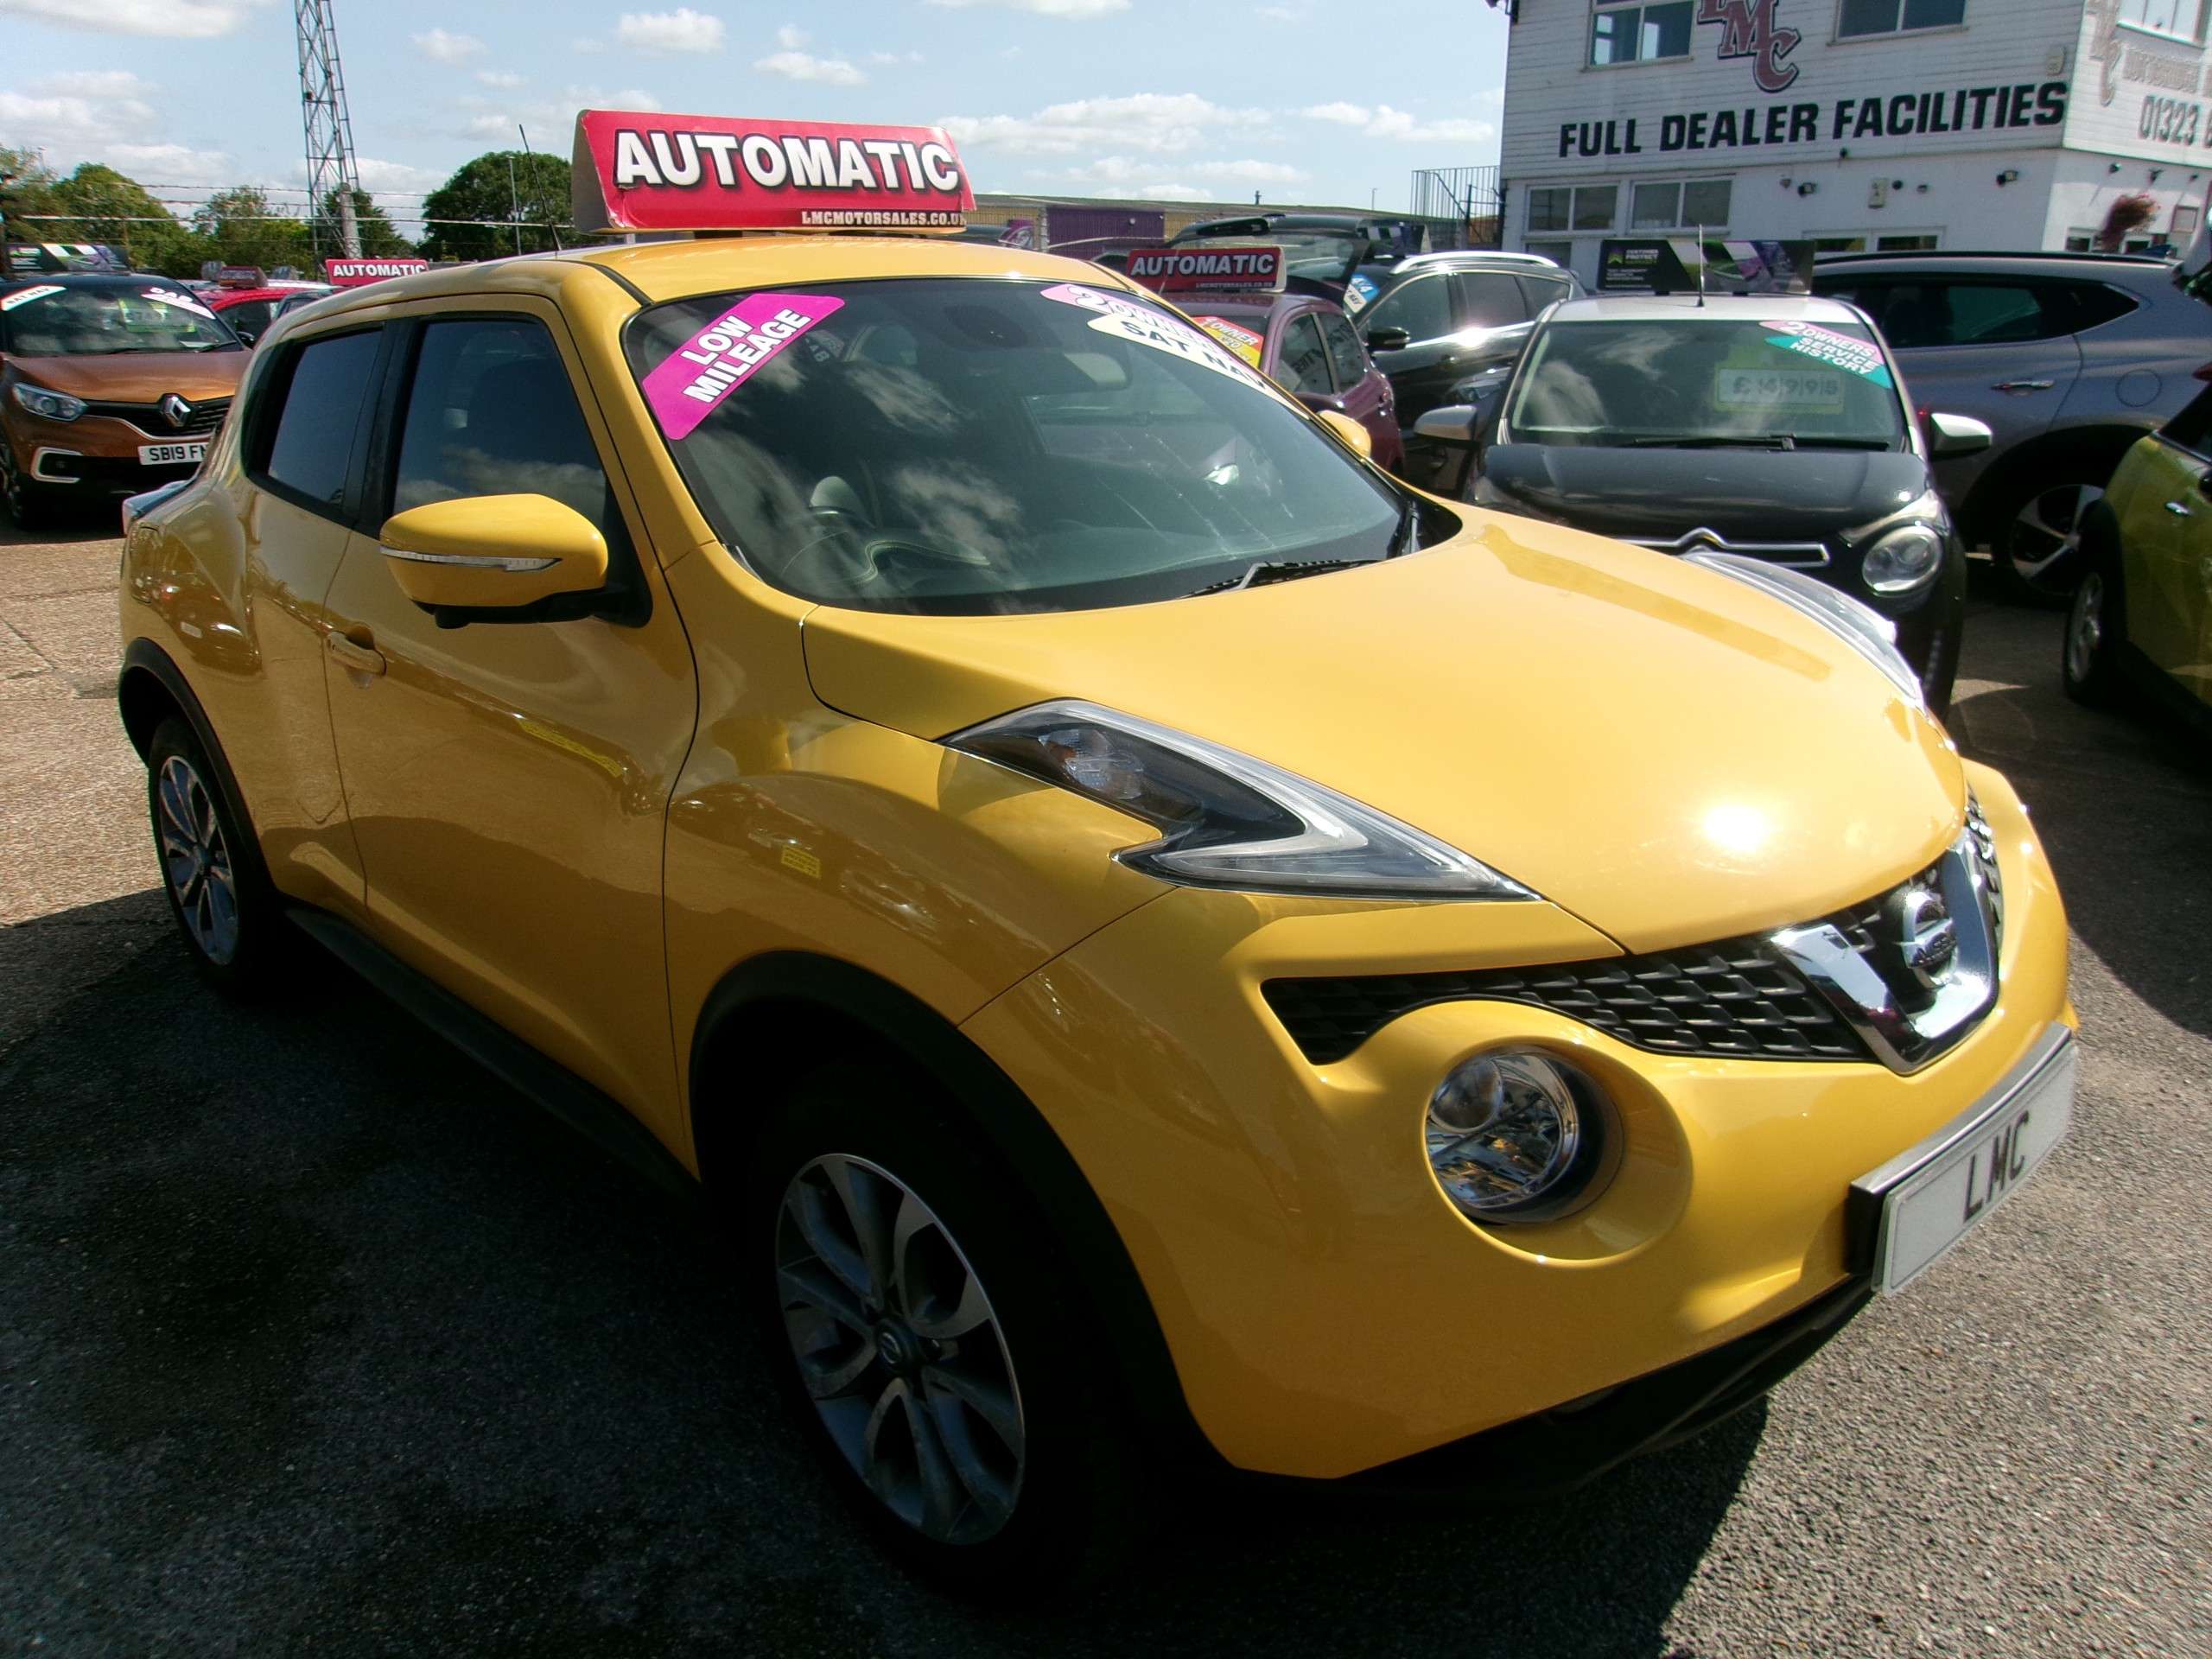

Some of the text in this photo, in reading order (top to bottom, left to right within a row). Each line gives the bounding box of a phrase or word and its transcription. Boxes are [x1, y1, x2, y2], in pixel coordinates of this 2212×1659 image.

[1559, 81, 2069, 158] FULL DEALER FACILITIES
[2139, 95, 2201, 146] 01323
[616, 131, 960, 192] AUTOMATIC
[332, 264, 426, 276] AUTOMATIC
[1129, 253, 1274, 276] AUTOMATIC
[680, 315, 755, 365] LOW
[1121, 321, 1189, 351] SAT
[1204, 351, 1267, 389] NAV
[1210, 321, 1259, 346] OWNER
[1780, 321, 1876, 357] 2 OWNERS
[1800, 337, 1880, 370] SERVICE
[683, 308, 814, 404] MILEAGE
[1790, 342, 1873, 374] HISTORY
[149, 446, 186, 461] SB19
[1963, 1109, 2030, 1224] LMC
